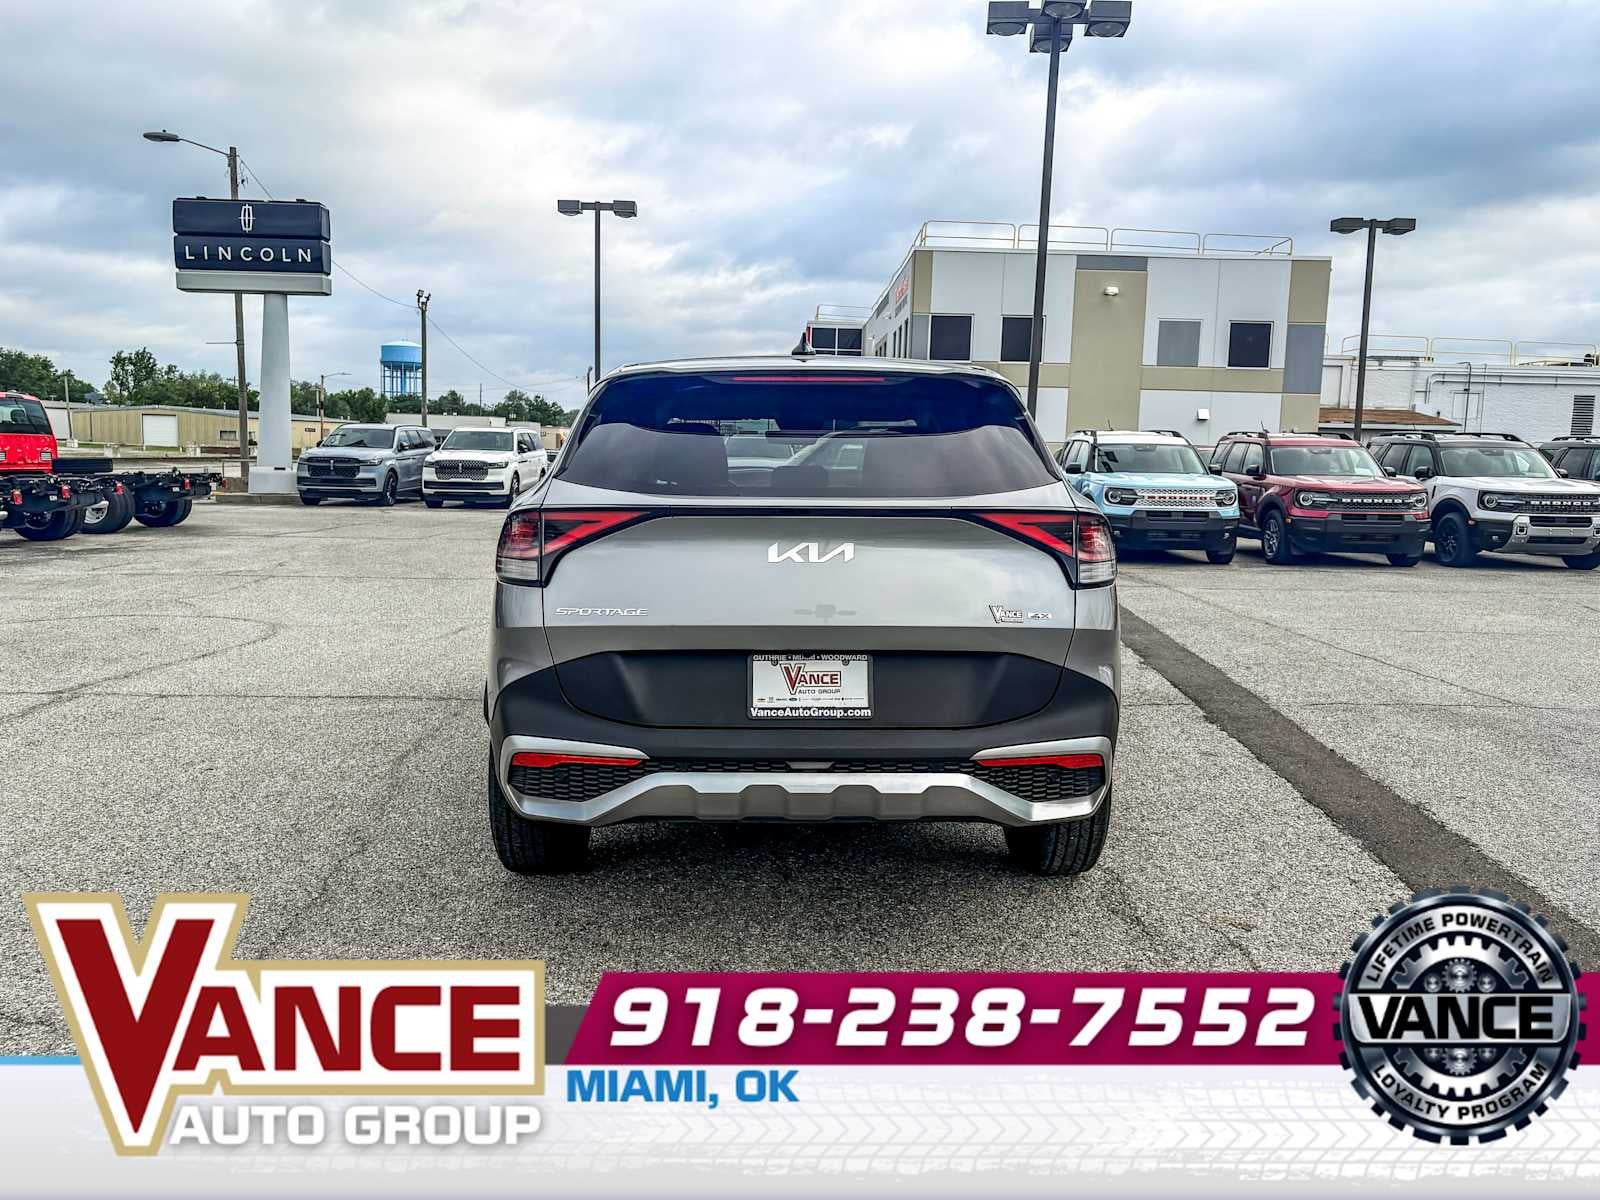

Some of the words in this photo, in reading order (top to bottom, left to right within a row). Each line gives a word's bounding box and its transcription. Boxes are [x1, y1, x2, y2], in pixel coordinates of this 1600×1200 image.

[185, 245, 312, 263] LINCOLN
[768, 542, 855, 563] KIA
[555, 607, 648, 616] SPORTAGE
[783, 665, 839, 691] VANCE
[750, 707, 872, 718] VanceAutoGroup.com
